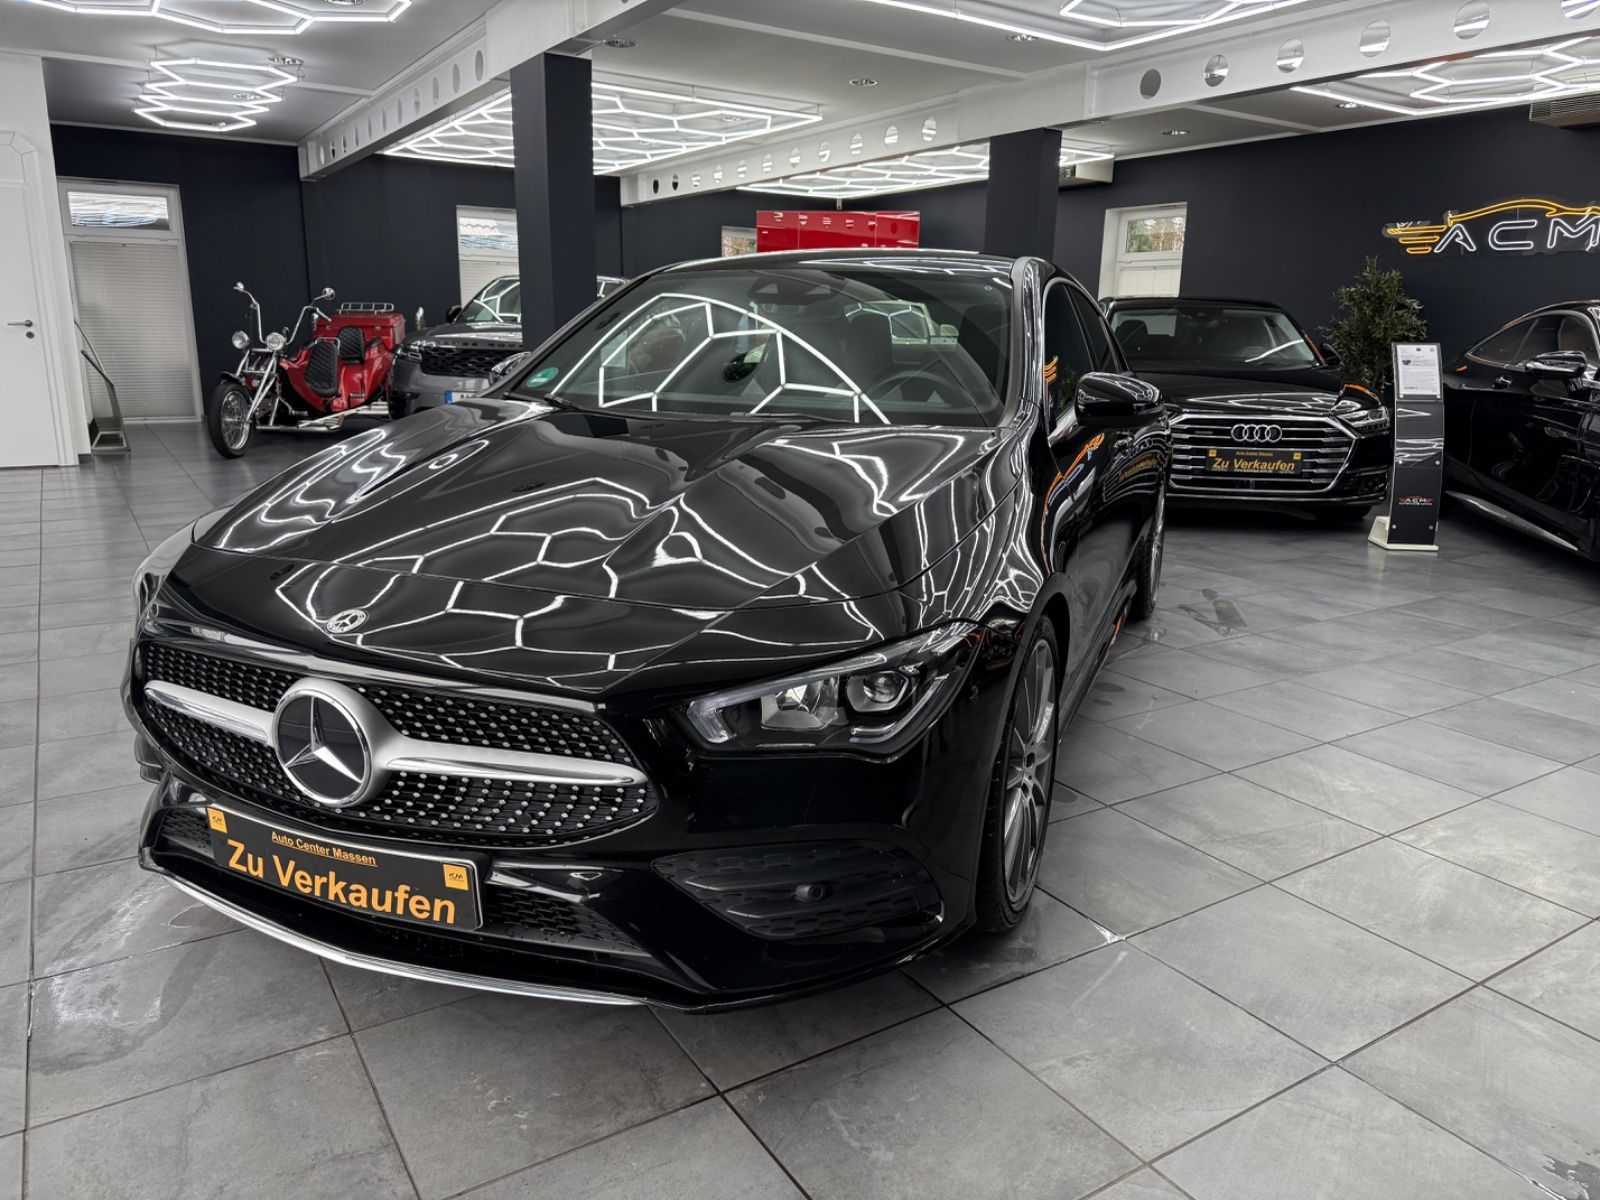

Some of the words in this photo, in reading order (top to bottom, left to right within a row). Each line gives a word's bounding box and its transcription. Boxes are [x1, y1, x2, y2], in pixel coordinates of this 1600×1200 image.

[1433, 216, 1600, 253] ACM
[1212, 457, 1229, 469] Zu
[1233, 458, 1295, 471] Verkaufen
[271, 831, 294, 847] Auto
[296, 838, 331, 856] Center
[332, 847, 376, 865] Massen
[227, 839, 264, 879] Zu
[272, 854, 456, 924] Verkaufen
